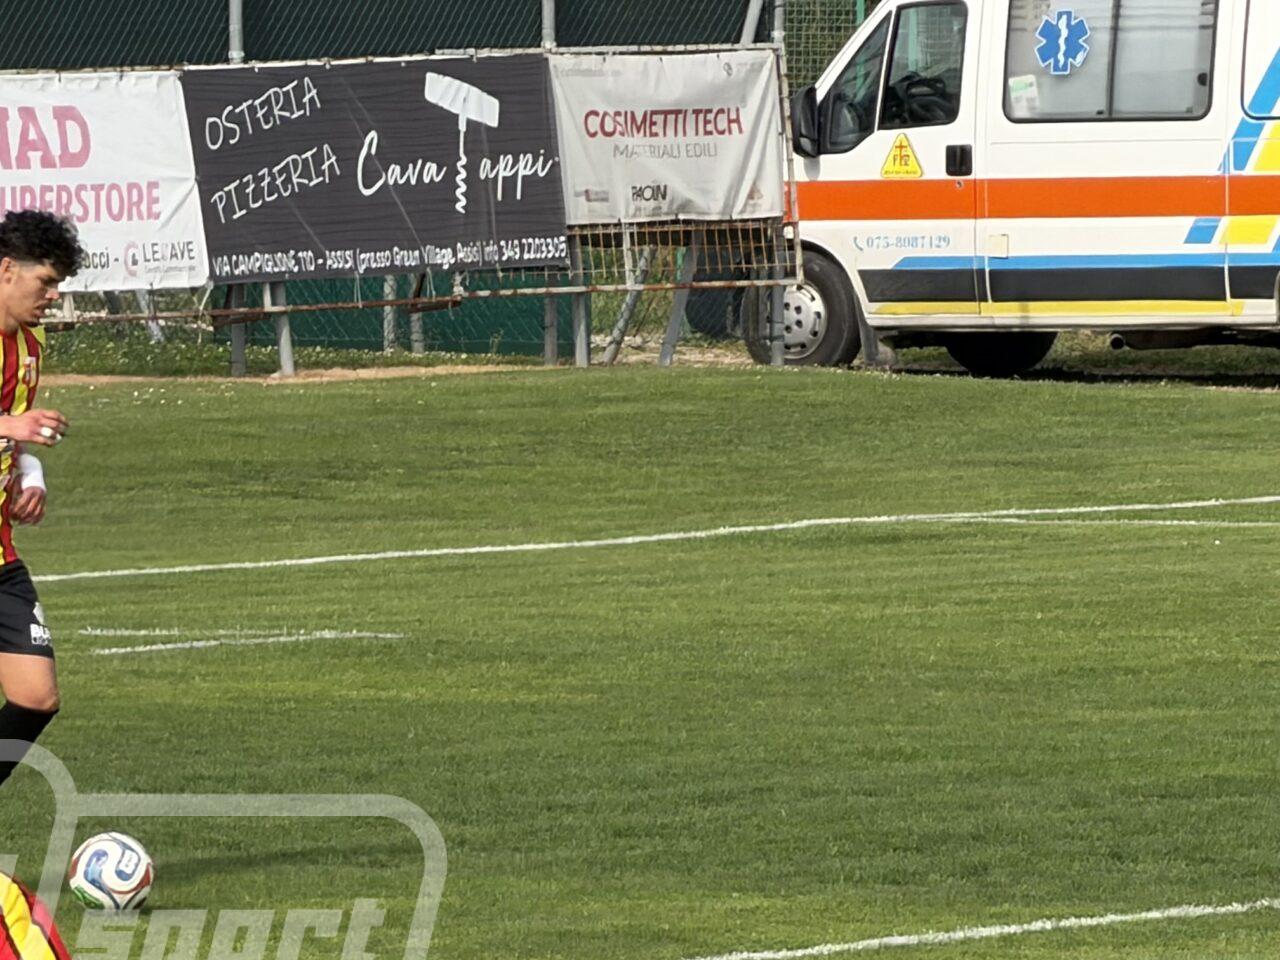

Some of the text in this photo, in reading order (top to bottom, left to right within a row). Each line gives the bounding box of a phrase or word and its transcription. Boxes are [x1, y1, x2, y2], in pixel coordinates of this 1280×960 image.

[205, 76, 320, 150] OSTERIA
[692, 106, 744, 137] TECH
[357, 130, 447, 197] Cava
[613, 144, 681, 159] MARIALI
[210, 143, 340, 224] PIZZERIA
[212, 255, 231, 277] VIA
